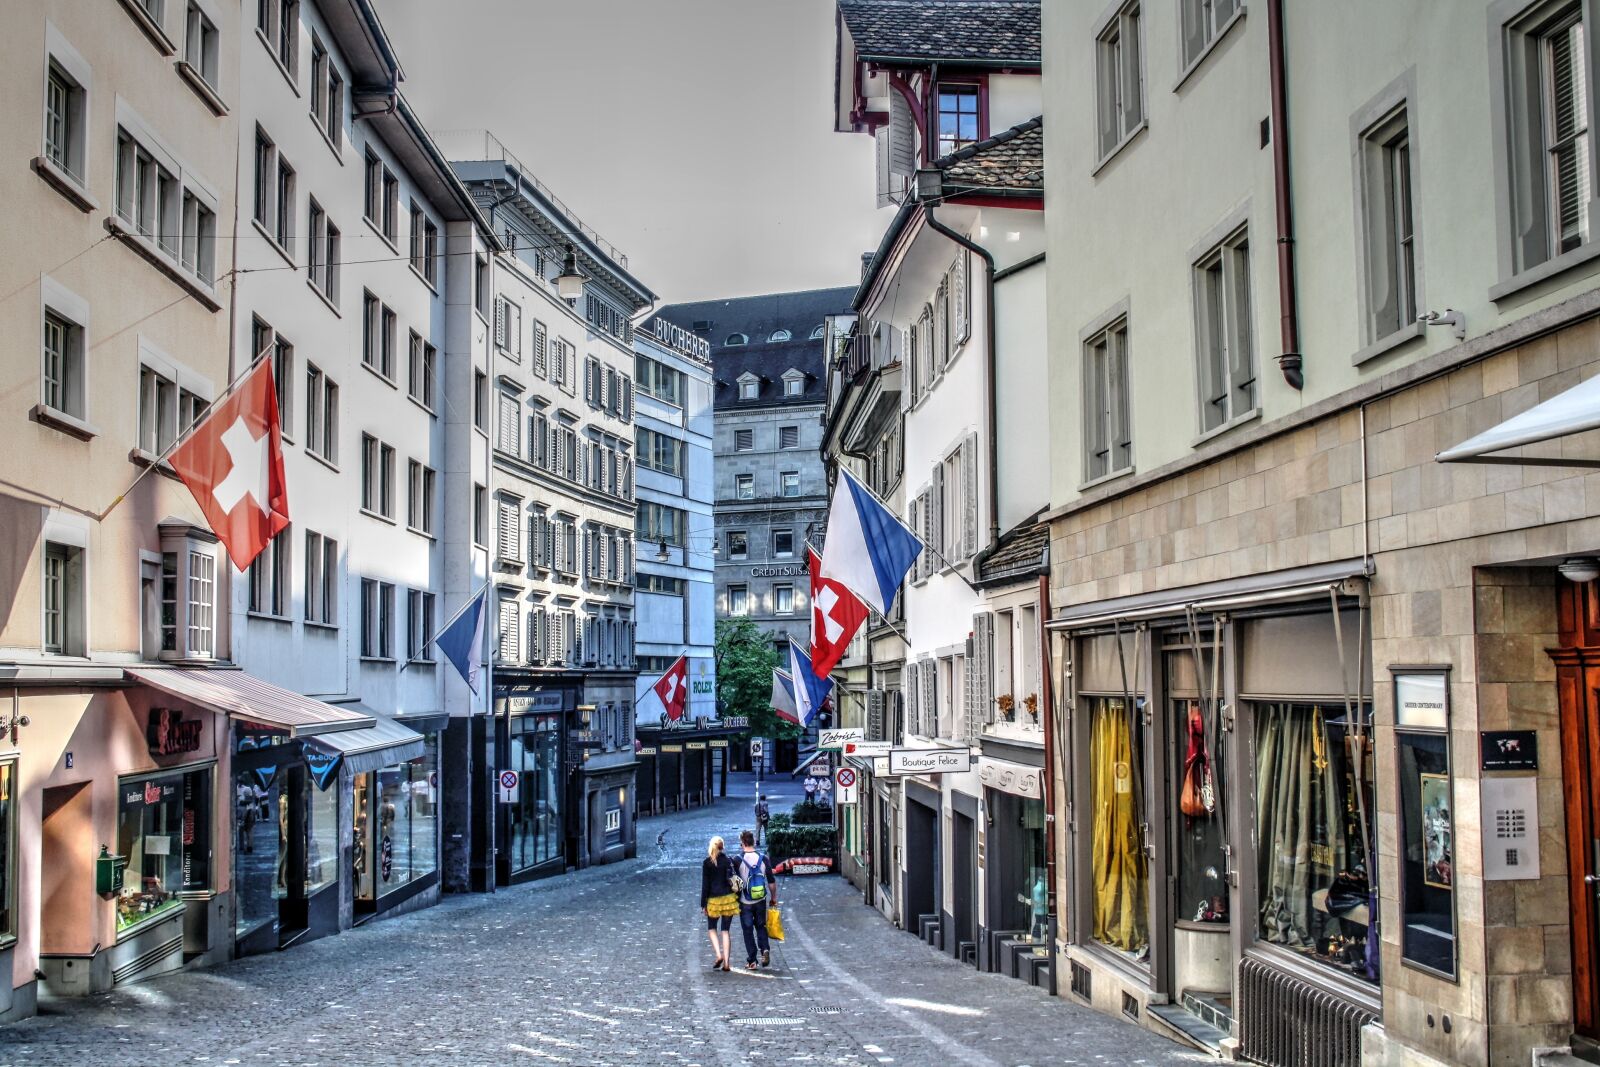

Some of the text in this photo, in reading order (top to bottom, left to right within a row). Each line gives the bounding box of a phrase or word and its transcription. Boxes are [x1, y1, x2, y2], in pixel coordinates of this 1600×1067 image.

[655, 317, 710, 361] BUCHERER
[693, 681, 713, 694] ROLEX
[822, 731, 862, 746] Zobrist
[902, 755, 958, 767] Boutique Felice
